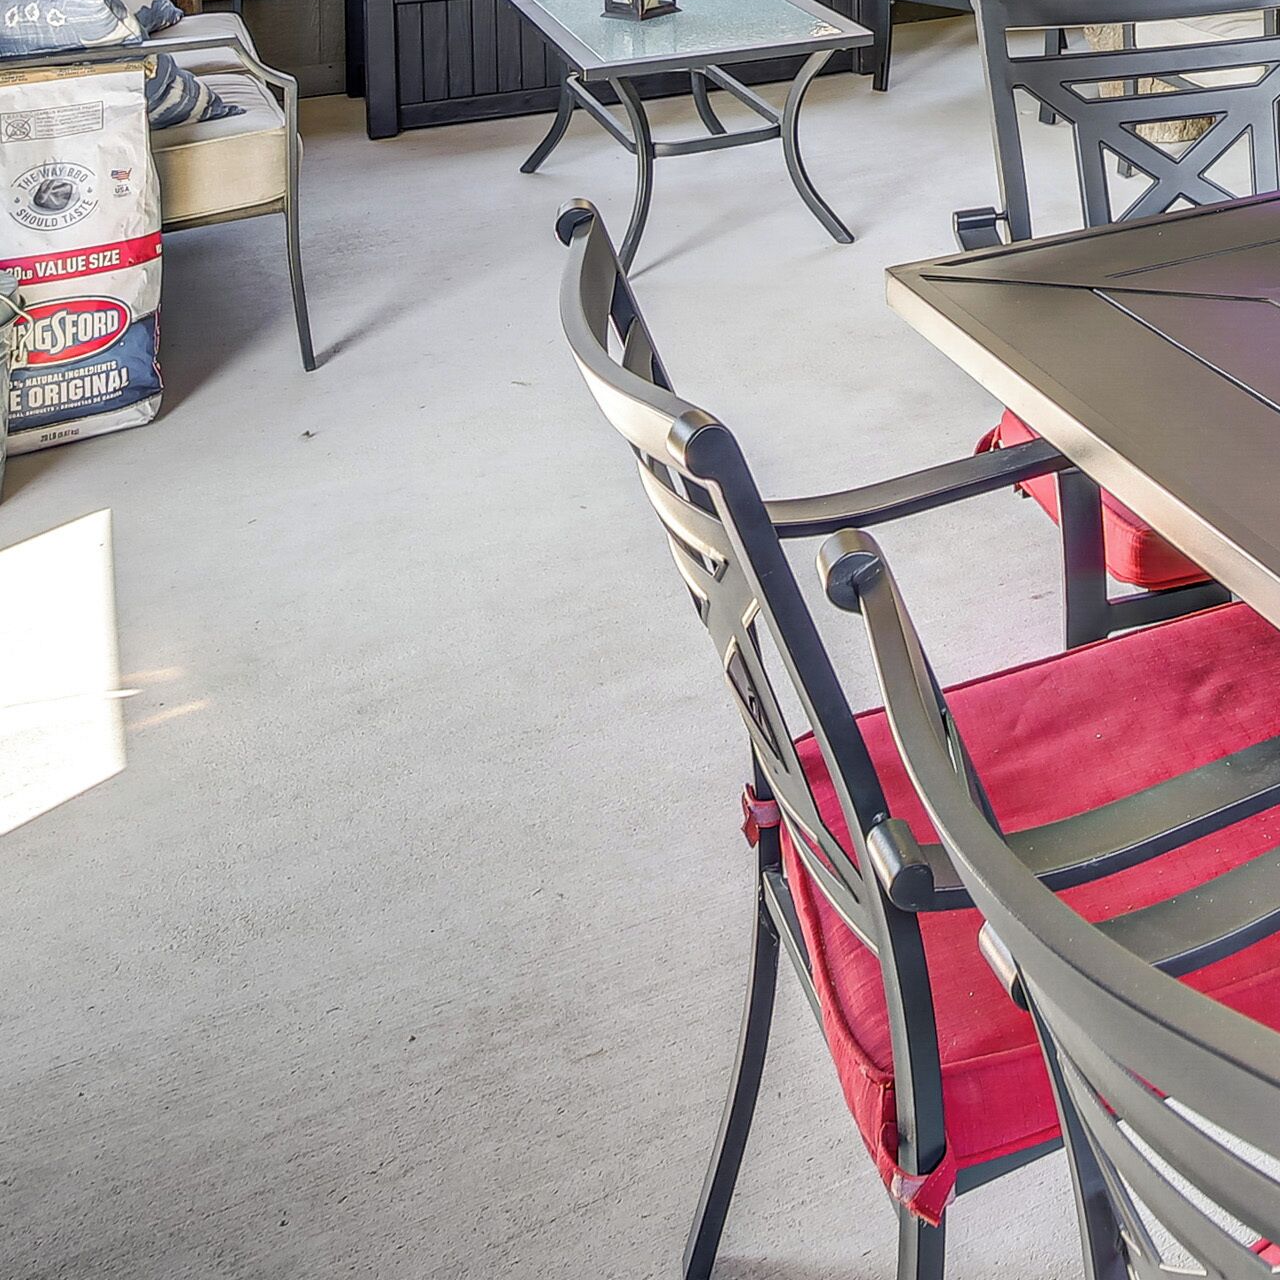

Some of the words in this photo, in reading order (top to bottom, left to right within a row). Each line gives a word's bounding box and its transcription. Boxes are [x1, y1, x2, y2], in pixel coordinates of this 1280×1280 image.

[17, 173, 38, 191] THE
[41, 166, 65, 179] WAY
[16, 208, 58, 228] SHOULD
[62, 199, 93, 224] TASTE
[35, 255, 87, 277] VALUE
[89, 249, 120, 269] SIZE
[12, 310, 119, 355] INGSFORD
[25, 372, 63, 389] NATURAL
[65, 361, 117, 381] INGREDIENTS
[28, 367, 130, 409] ORIGINAL
